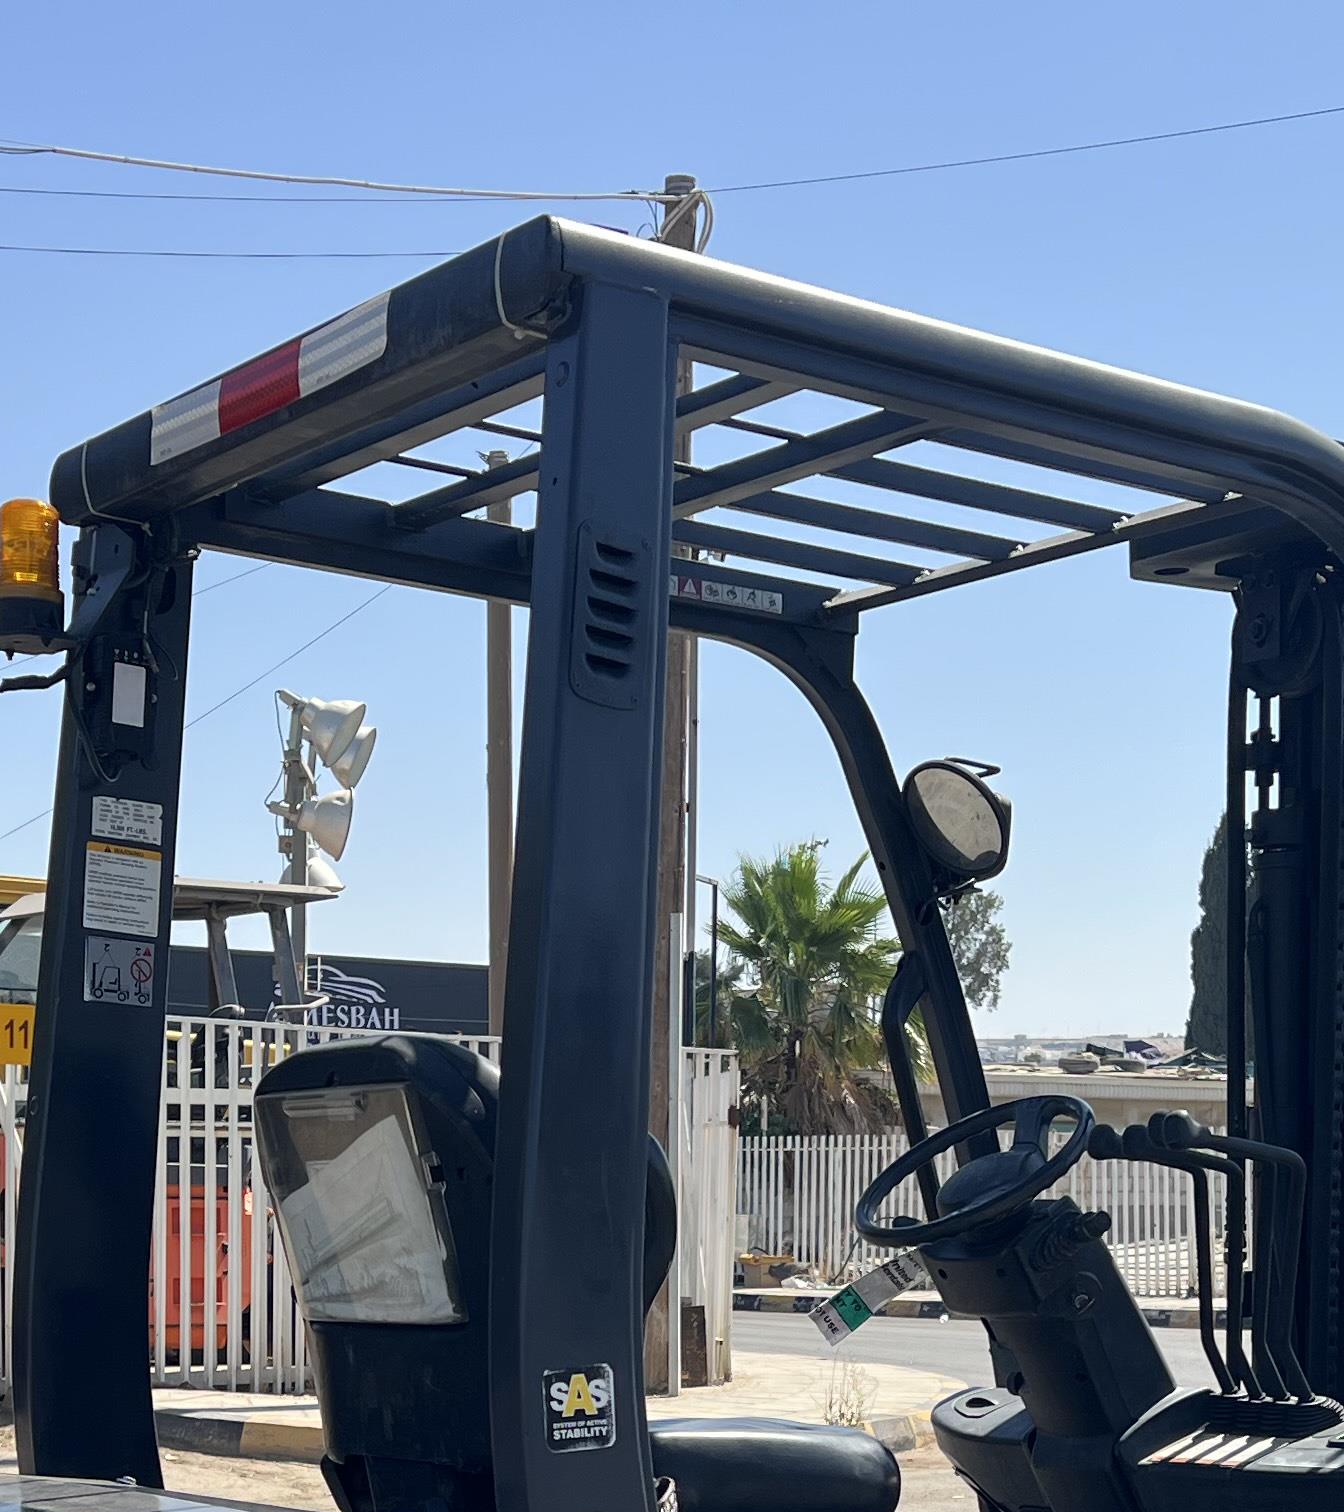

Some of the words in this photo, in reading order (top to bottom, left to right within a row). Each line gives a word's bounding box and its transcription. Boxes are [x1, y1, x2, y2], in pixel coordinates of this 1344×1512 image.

[823, 1315, 839, 1335] USE
[550, 1374, 609, 1417] SAS
[553, 1421, 576, 1429] SYSTEM
[586, 1419, 608, 1427] ACTIVE
[553, 1426, 608, 1440] STABILITY
